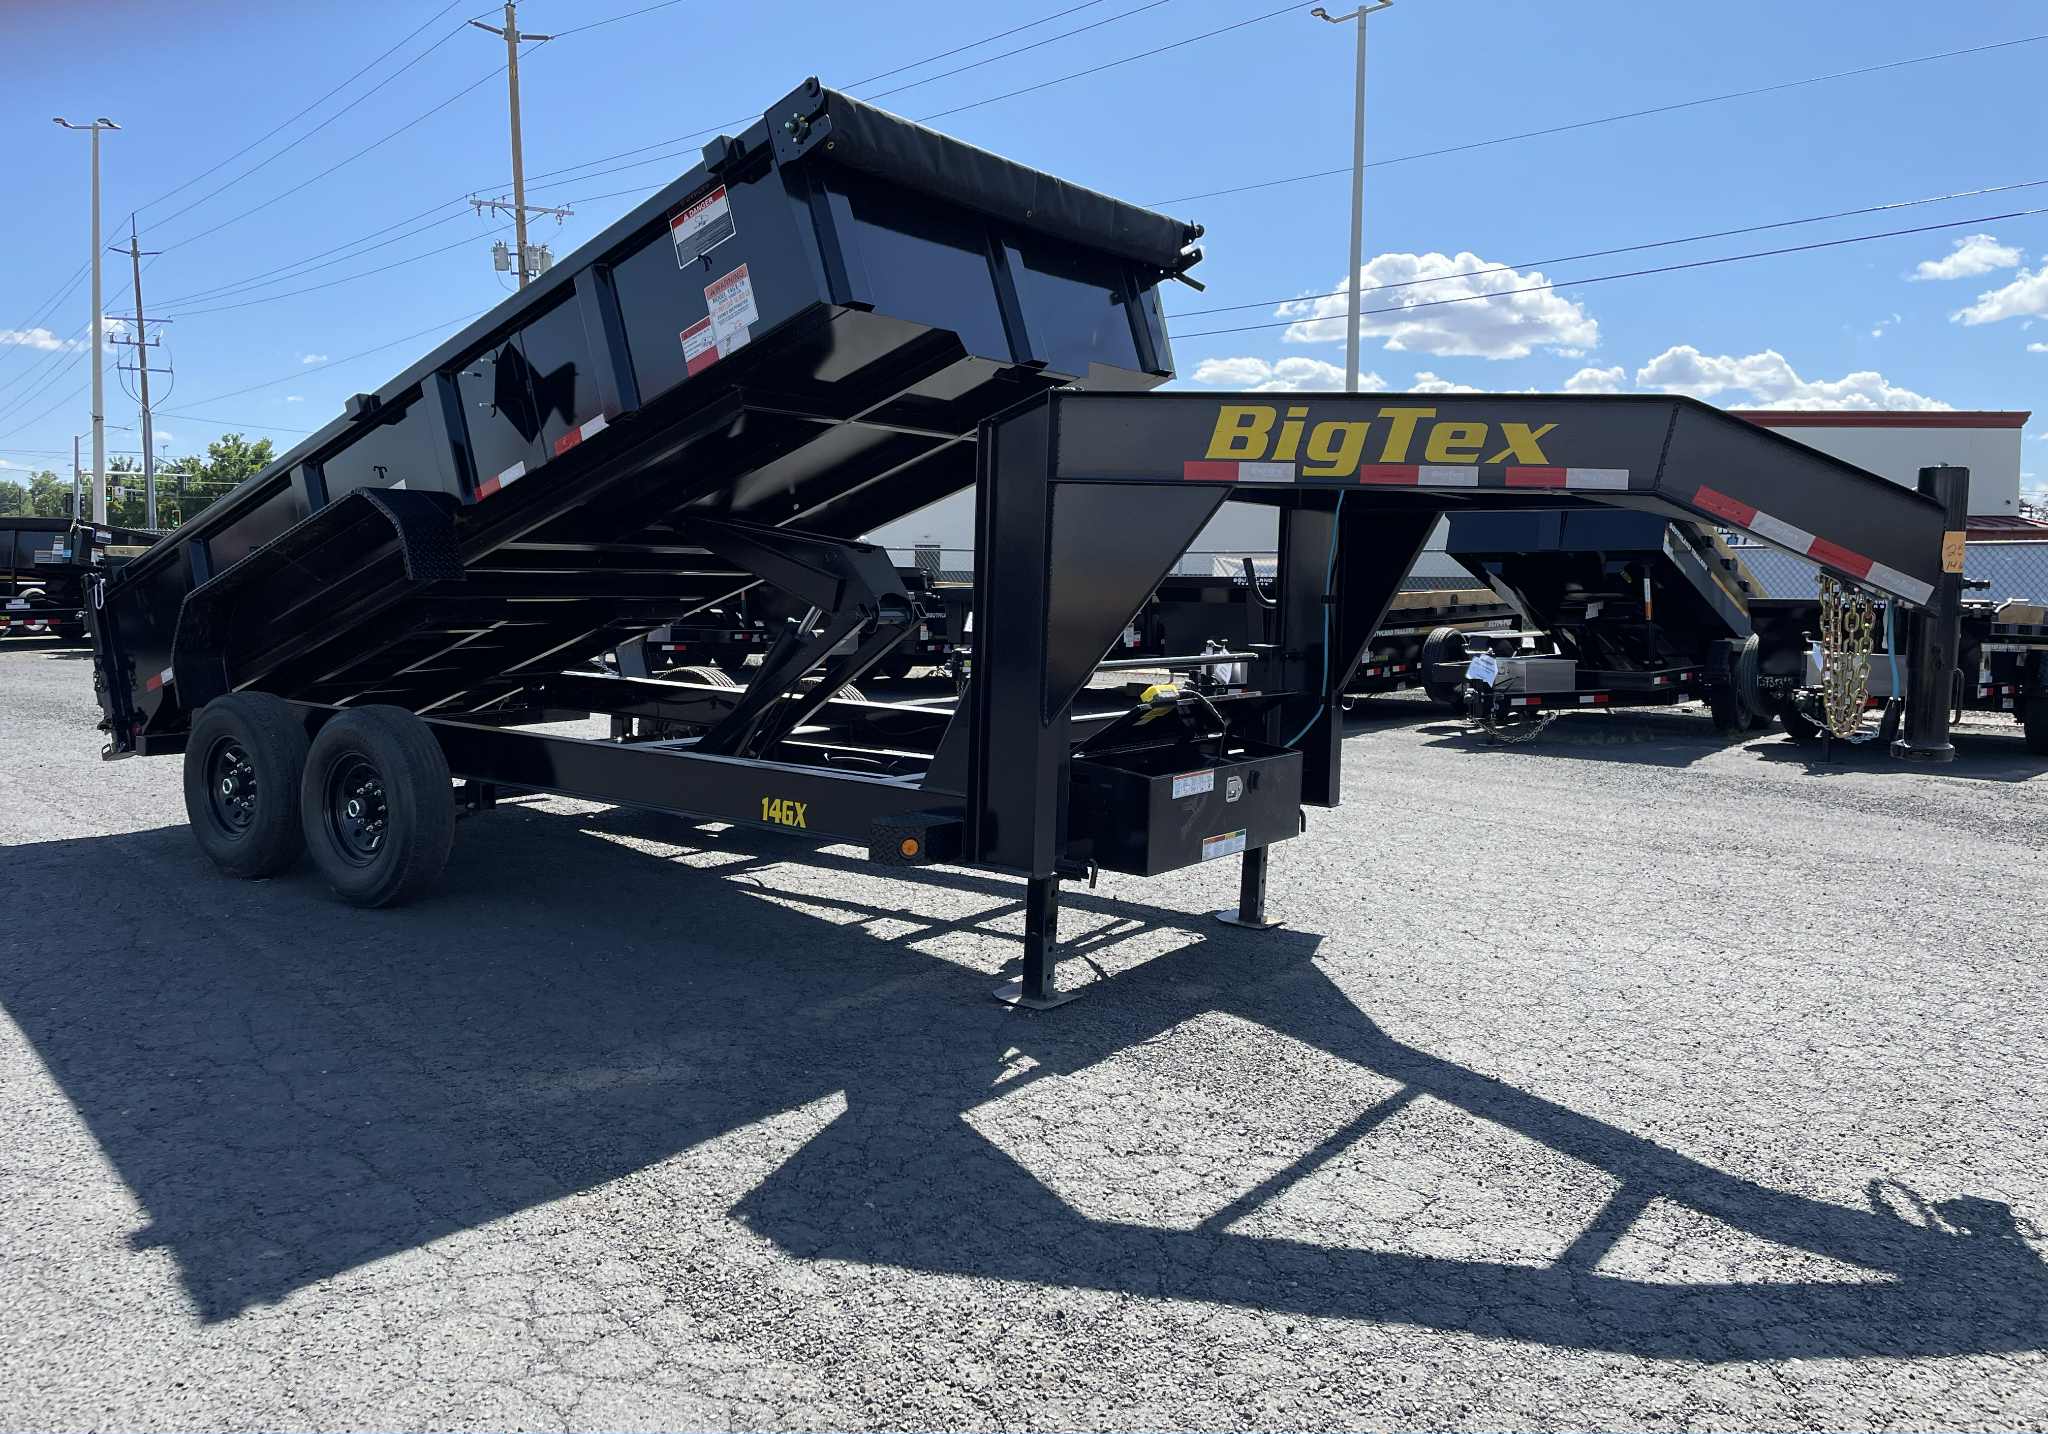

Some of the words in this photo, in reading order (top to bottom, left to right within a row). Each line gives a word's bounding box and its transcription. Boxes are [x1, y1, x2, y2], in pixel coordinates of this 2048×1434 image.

[689, 196, 714, 217] DANGER
[1205, 404, 1559, 477] BigTex
[761, 796, 808, 828] 14GX
